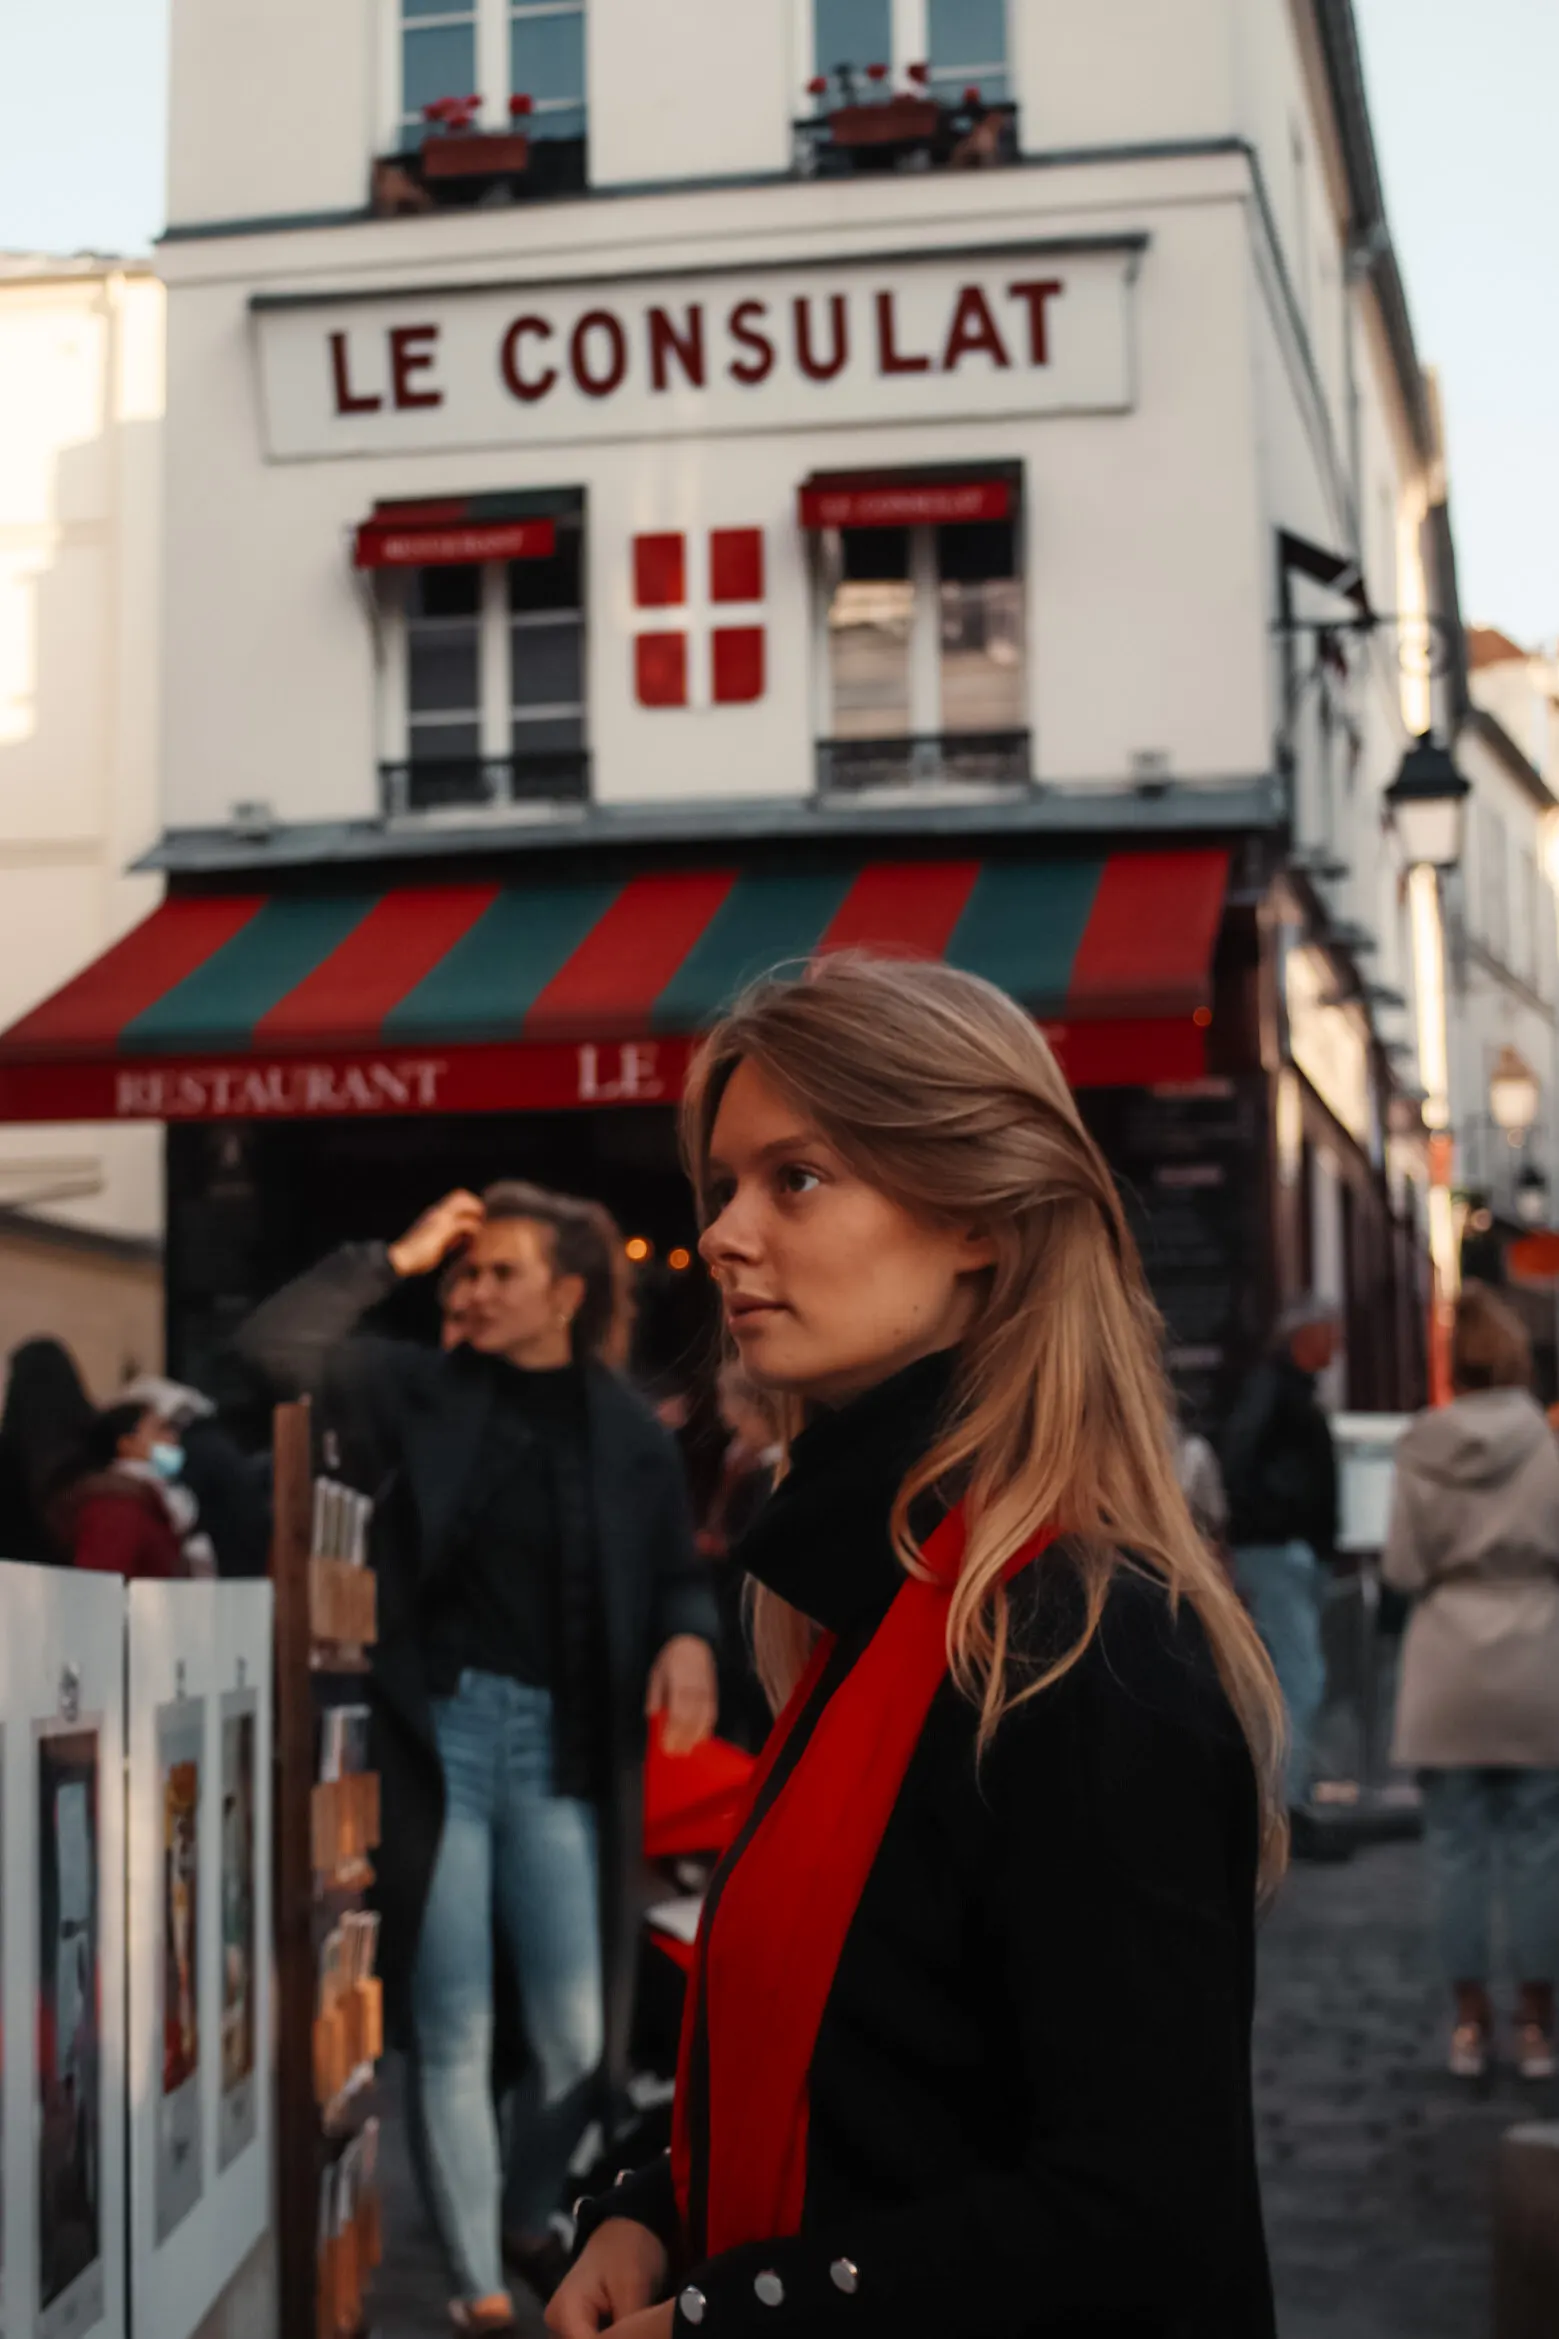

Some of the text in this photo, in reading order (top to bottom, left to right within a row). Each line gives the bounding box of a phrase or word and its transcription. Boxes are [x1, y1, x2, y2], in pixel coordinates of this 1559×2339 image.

[328, 280, 1063, 416] LE CONSULAT
[115, 1042, 664, 1114] RESTAURANT LE
